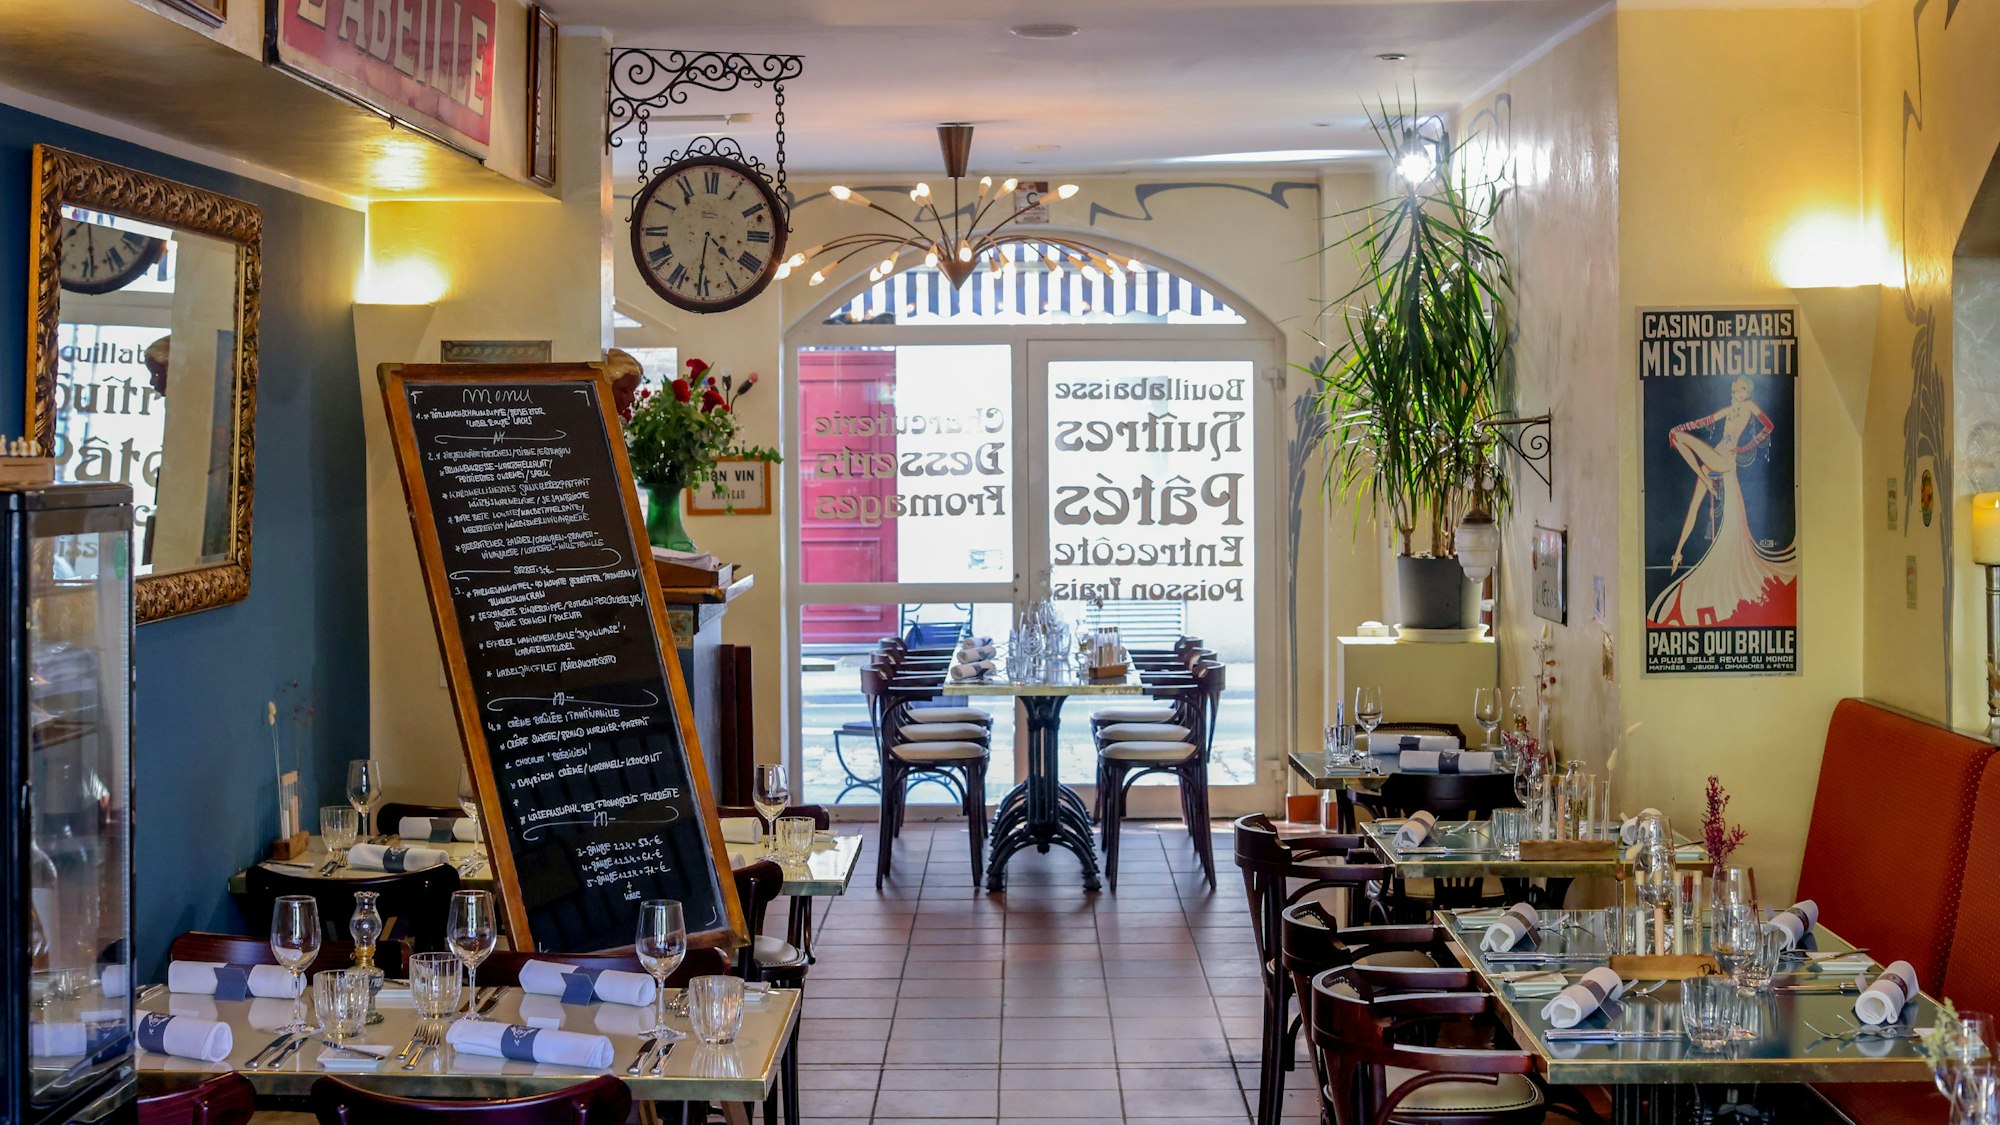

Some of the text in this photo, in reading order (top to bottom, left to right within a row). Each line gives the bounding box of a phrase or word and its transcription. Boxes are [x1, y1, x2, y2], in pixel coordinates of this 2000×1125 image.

[1645, 313, 1792, 339] CASINO DE PARIS
[1642, 339, 1795, 377] MISTINGUETT
[735, 470, 755, 481] VIN
[1649, 630, 1794, 655] PARIS QUI BRILLE
[1649, 655, 1794, 664] LA PLUS BELLE REVUE DU MONDE
